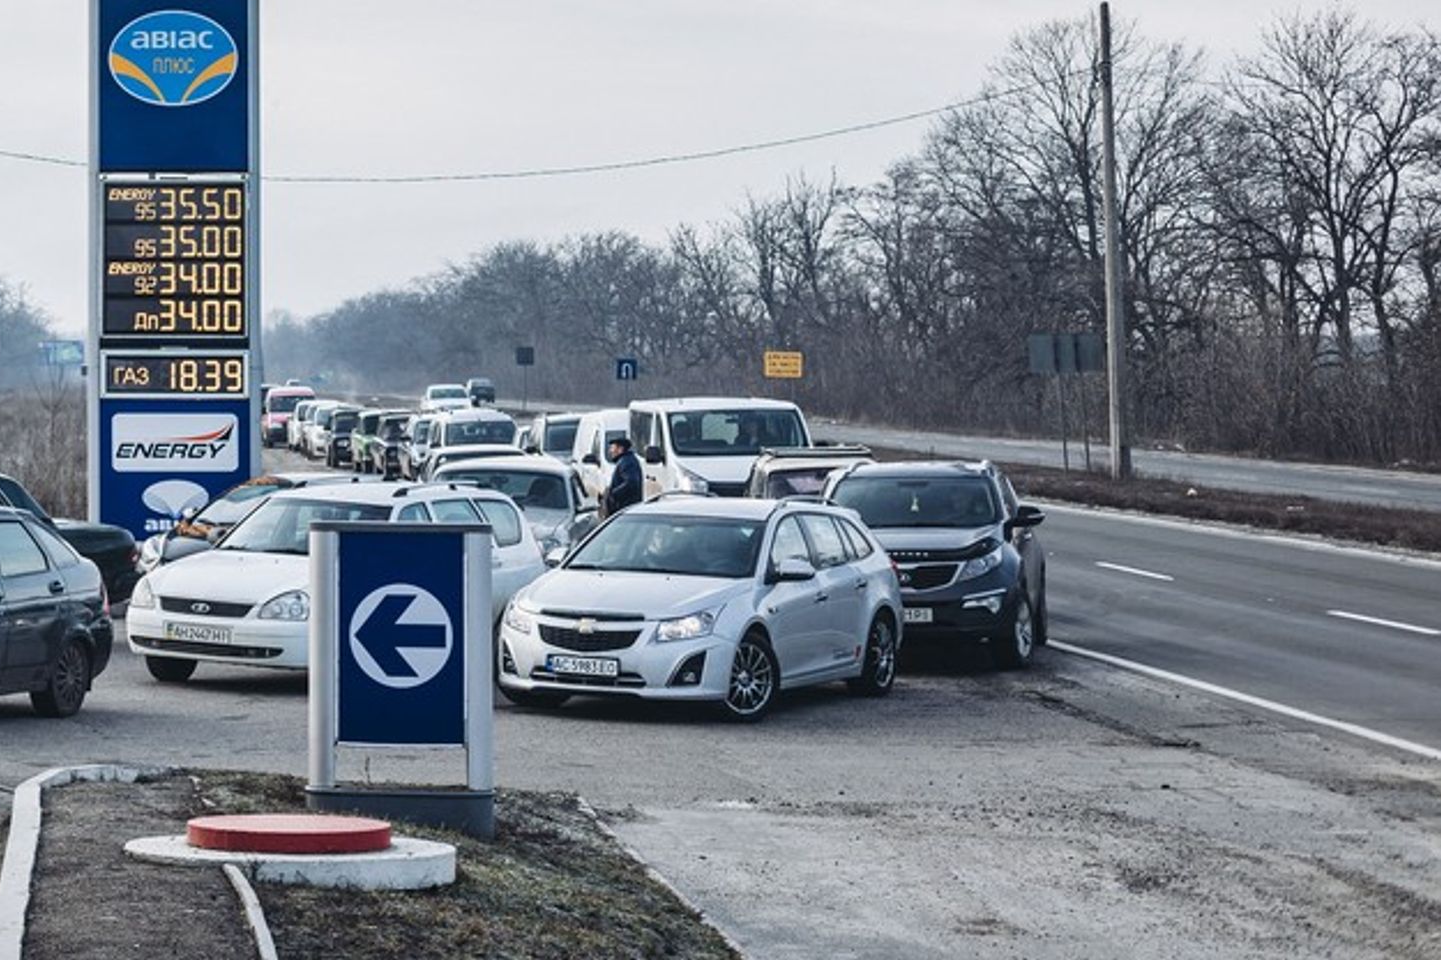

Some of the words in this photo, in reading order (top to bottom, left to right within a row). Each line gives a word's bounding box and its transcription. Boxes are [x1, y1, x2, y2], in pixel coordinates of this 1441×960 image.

[108, 189, 157, 201] ENERGY
[134, 202, 157, 221] 95
[160, 188, 242, 220] 35.50
[134, 239, 157, 258] 95
[160, 225, 242, 257] 35.00
[108, 262, 157, 275] ENERGY
[134, 276, 158, 295] 92
[160, 262, 242, 295] 34.00
[160, 300, 242, 331] 34.00
[113, 367, 150, 385] ГАЗ
[169, 359, 242, 391] 18.39
[115, 443, 227, 459] ENERGY
